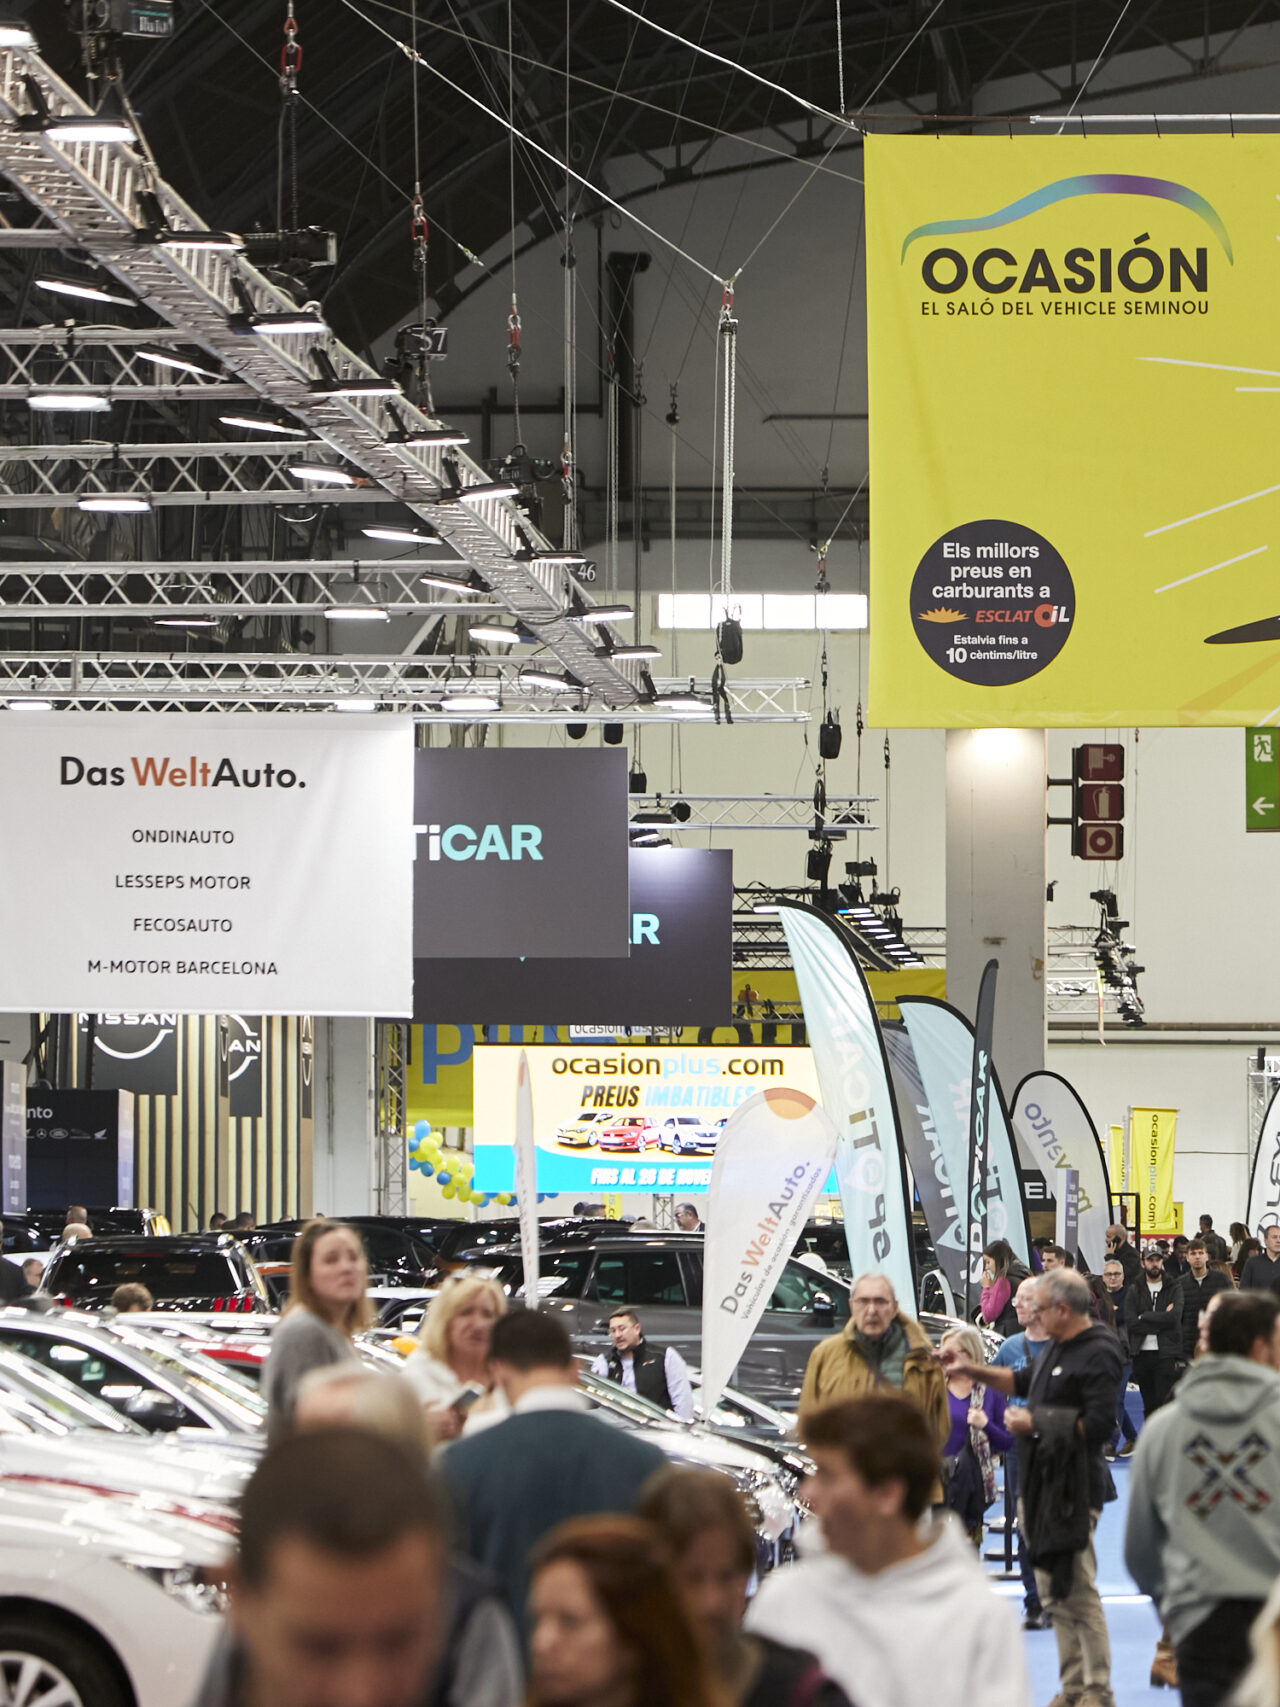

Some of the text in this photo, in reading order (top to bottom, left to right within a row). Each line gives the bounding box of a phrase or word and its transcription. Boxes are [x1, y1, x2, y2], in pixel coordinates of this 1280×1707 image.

[921, 232, 1209, 294] OCASIÓN
[921, 298, 1209, 316] EL SALÓ DEL VEHICLE SEMINOU
[943, 543, 1040, 559] Els millors
[951, 566, 1032, 581] preus en
[932, 583, 1051, 599] carburants a
[953, 635, 1029, 645] Estalvia fins a
[946, 648, 1038, 663] 10 cèntims/litre
[60, 756, 306, 788] Das WeltAuto.
[131, 830, 235, 845] ONDINAUTO
[115, 875, 251, 890] LESSEPS MOTOR
[133, 918, 233, 932] FECOSAUTO
[87, 960, 279, 976] M-MOTOR BARCELONA
[552, 1052, 784, 1079] ocasionplus.com
[581, 1085, 641, 1108] PREUS
[720, 1271, 753, 1315] Das
